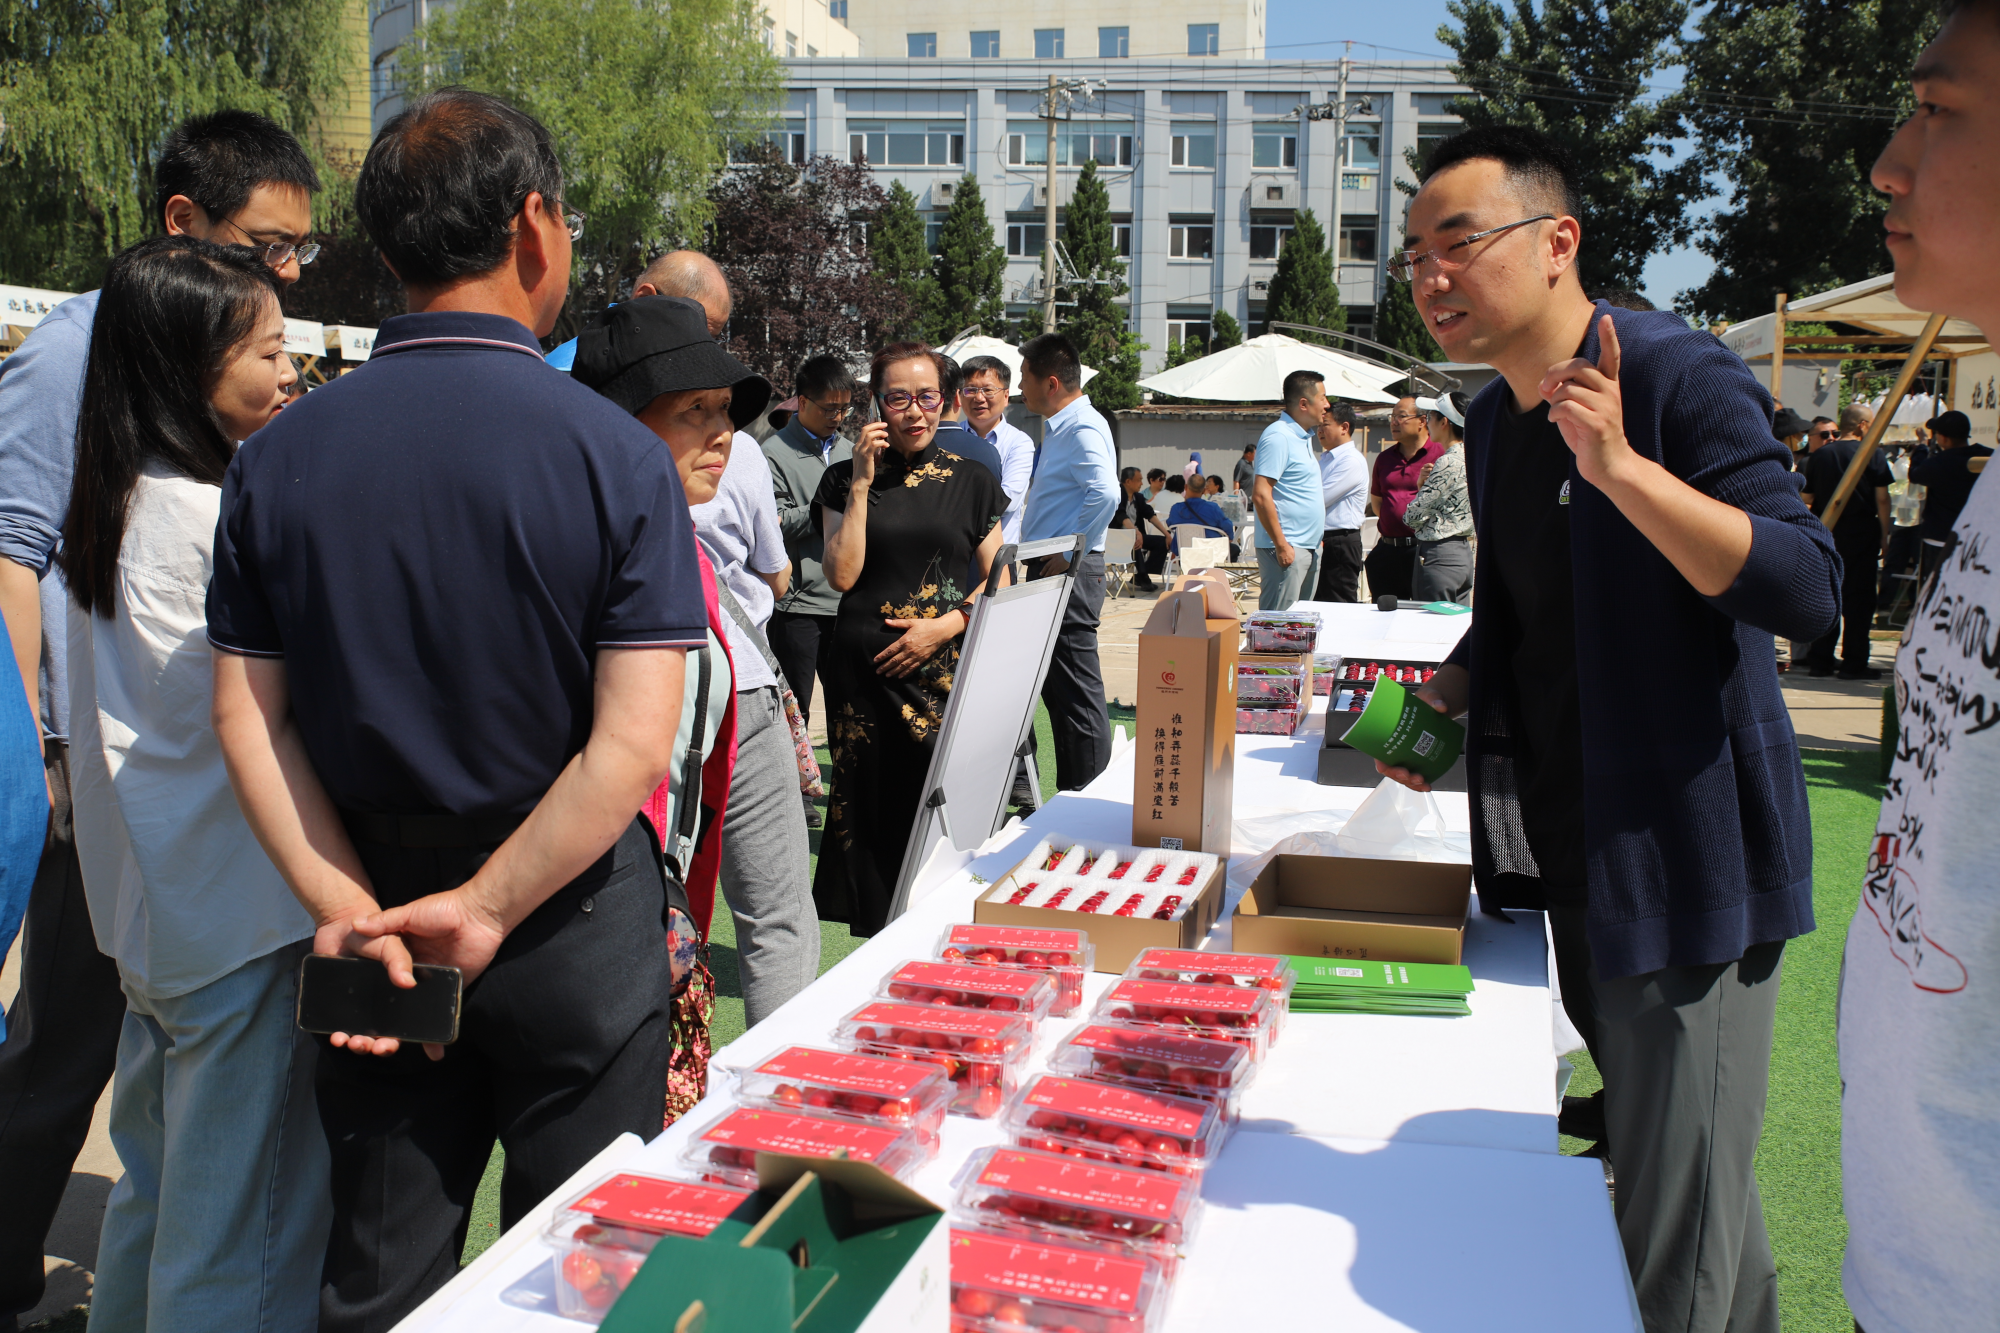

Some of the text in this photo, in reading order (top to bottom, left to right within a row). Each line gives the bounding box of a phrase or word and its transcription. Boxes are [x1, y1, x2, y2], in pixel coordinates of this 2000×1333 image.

[1152, 727, 1167, 820] 换得庭前满堂红
[1168, 713, 1183, 806] 谁知弄蕊千般苦
